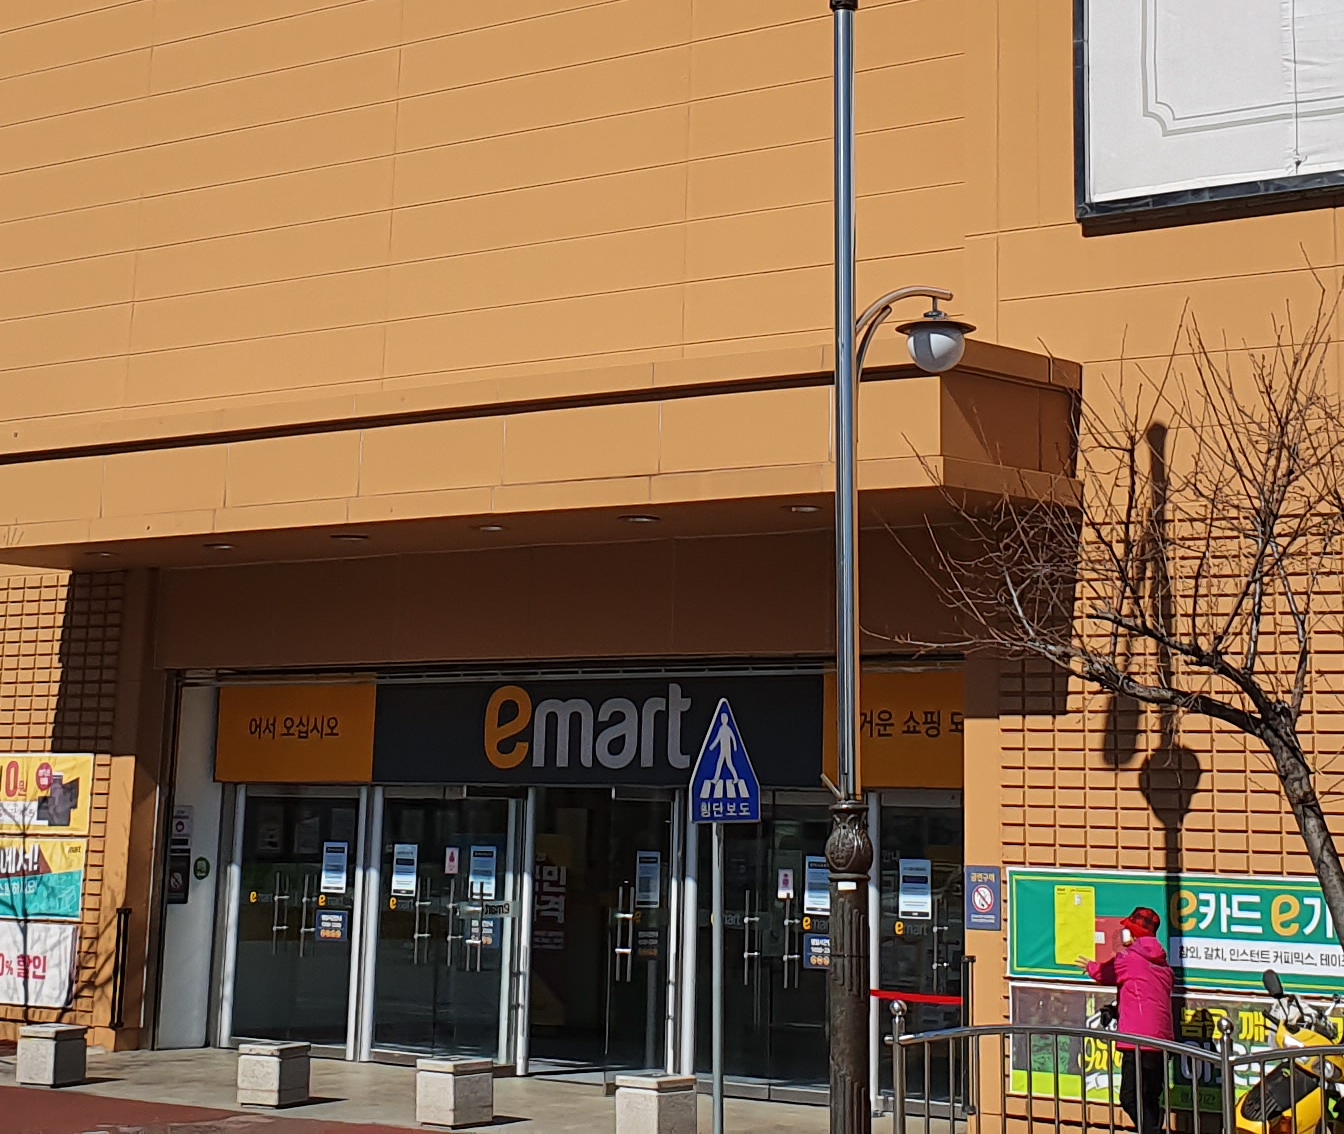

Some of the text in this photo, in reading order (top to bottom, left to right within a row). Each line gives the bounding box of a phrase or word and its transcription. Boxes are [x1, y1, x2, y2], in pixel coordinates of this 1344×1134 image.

[248, 714, 341, 741] 어서 오십시오
[483, 683, 693, 770] emart
[860, 710, 895, 738] 거운
[902, 710, 942, 739] 쇼핑
[1170, 890, 1264, 934] e카드
[16, 954, 47, 980] 할인
[1179, 946, 1202, 961] 참외,
[1203, 946, 1227, 962] 갈치,
[1229, 948, 1271, 964] 인스턴트
[1272, 950, 1318, 968] 커피믹스,
